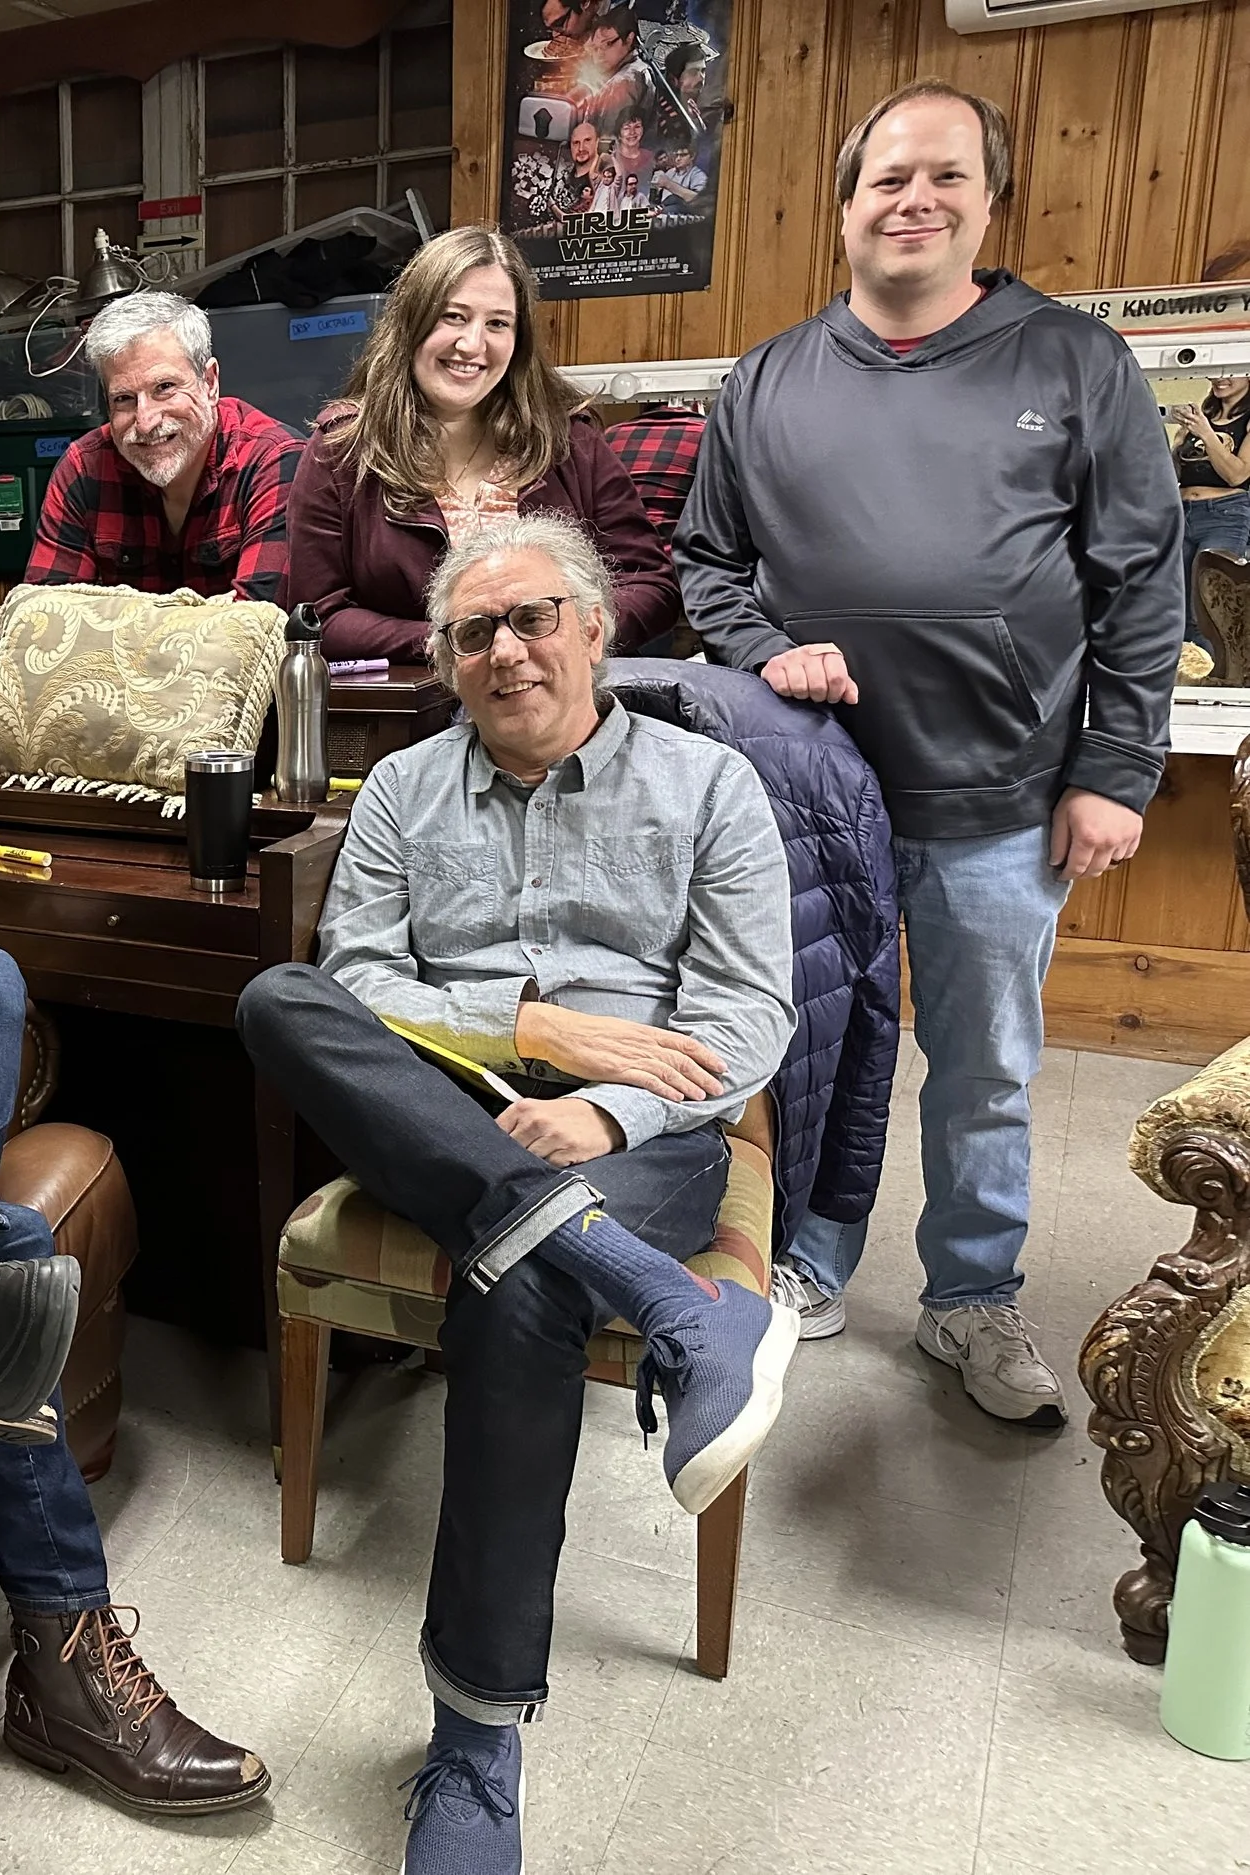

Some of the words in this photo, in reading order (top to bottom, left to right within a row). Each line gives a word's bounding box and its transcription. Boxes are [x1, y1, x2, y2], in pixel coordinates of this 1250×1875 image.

[160, 202, 181, 215] Exit
[562, 208, 652, 235] TRUE
[559, 233, 648, 261] WEST
[1090, 301, 1111, 319] IS
[1122, 295, 1228, 318] KNOWING
